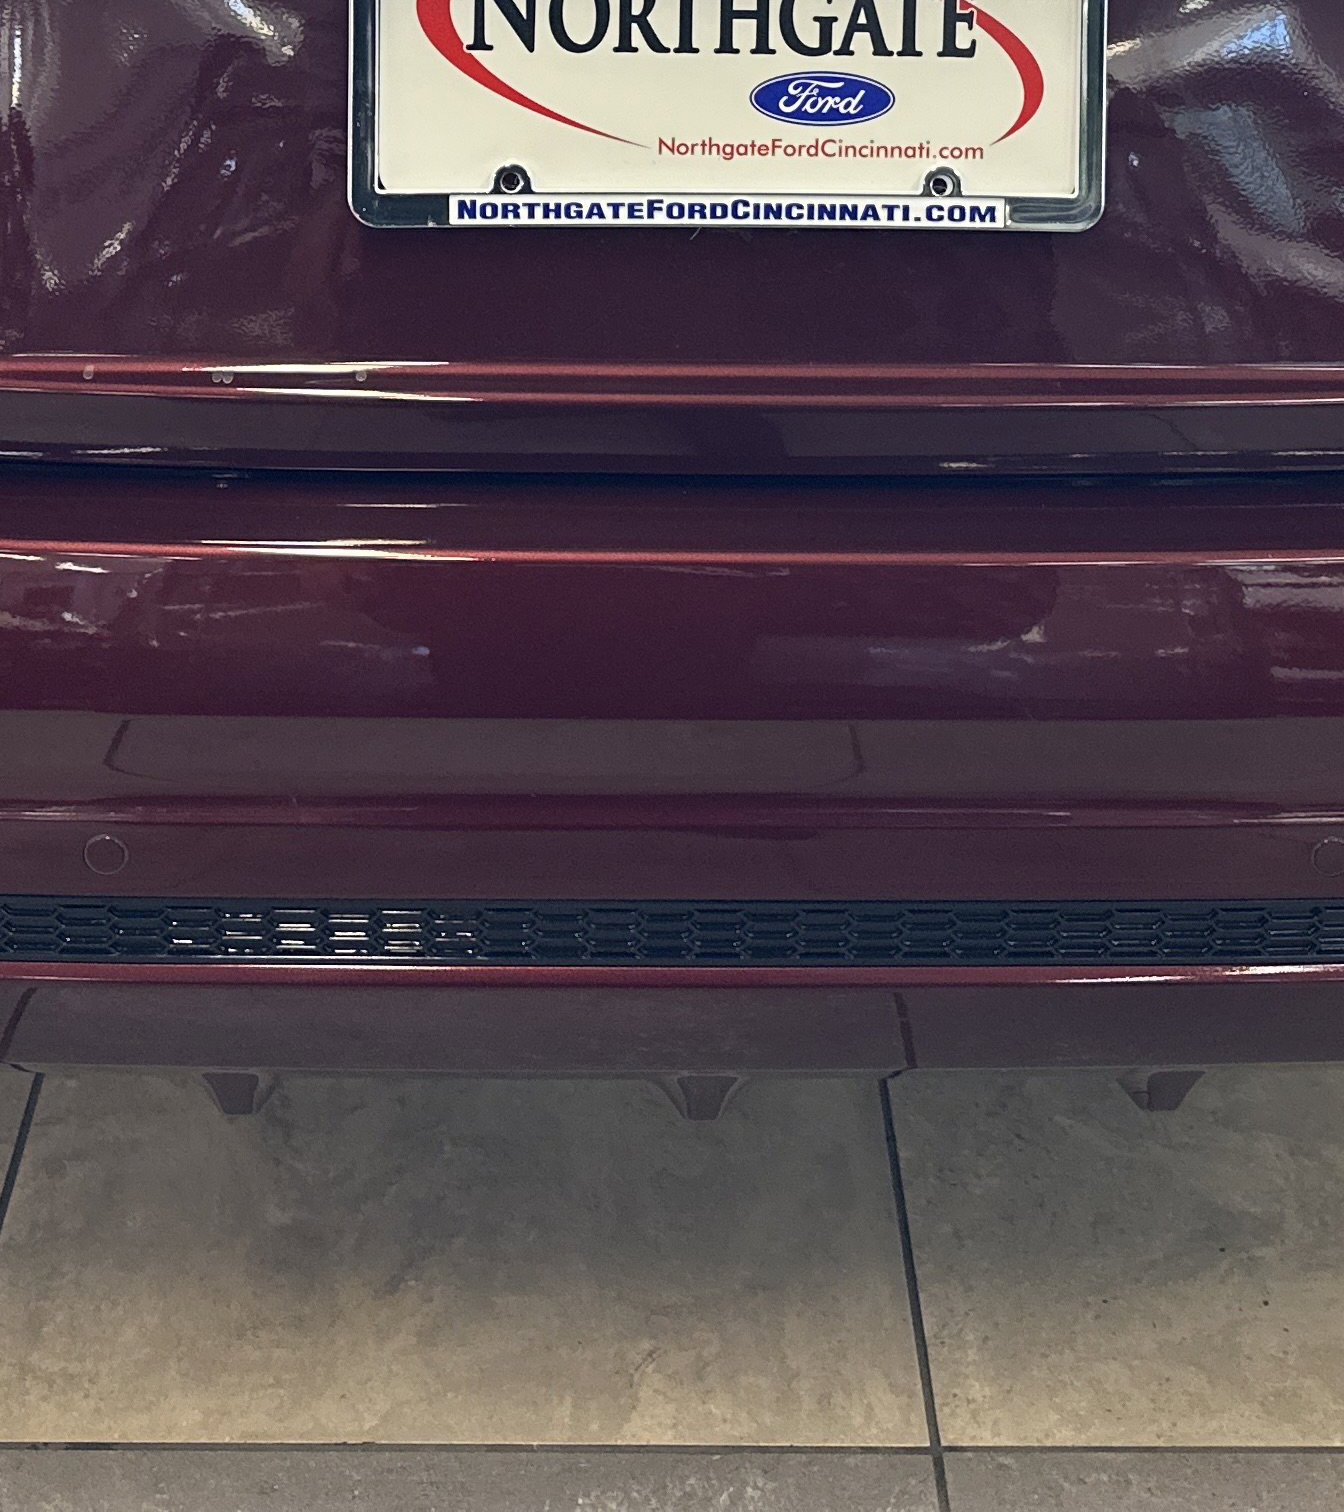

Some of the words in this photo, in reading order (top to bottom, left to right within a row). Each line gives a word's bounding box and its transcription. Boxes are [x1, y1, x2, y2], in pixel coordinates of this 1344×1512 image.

[778, 78, 866, 115] Ford
[657, 135, 985, 161] NorthgateFordCincinnati.com
[456, 198, 997, 224] NORTHGATEFORDCINCINNATI.COM
